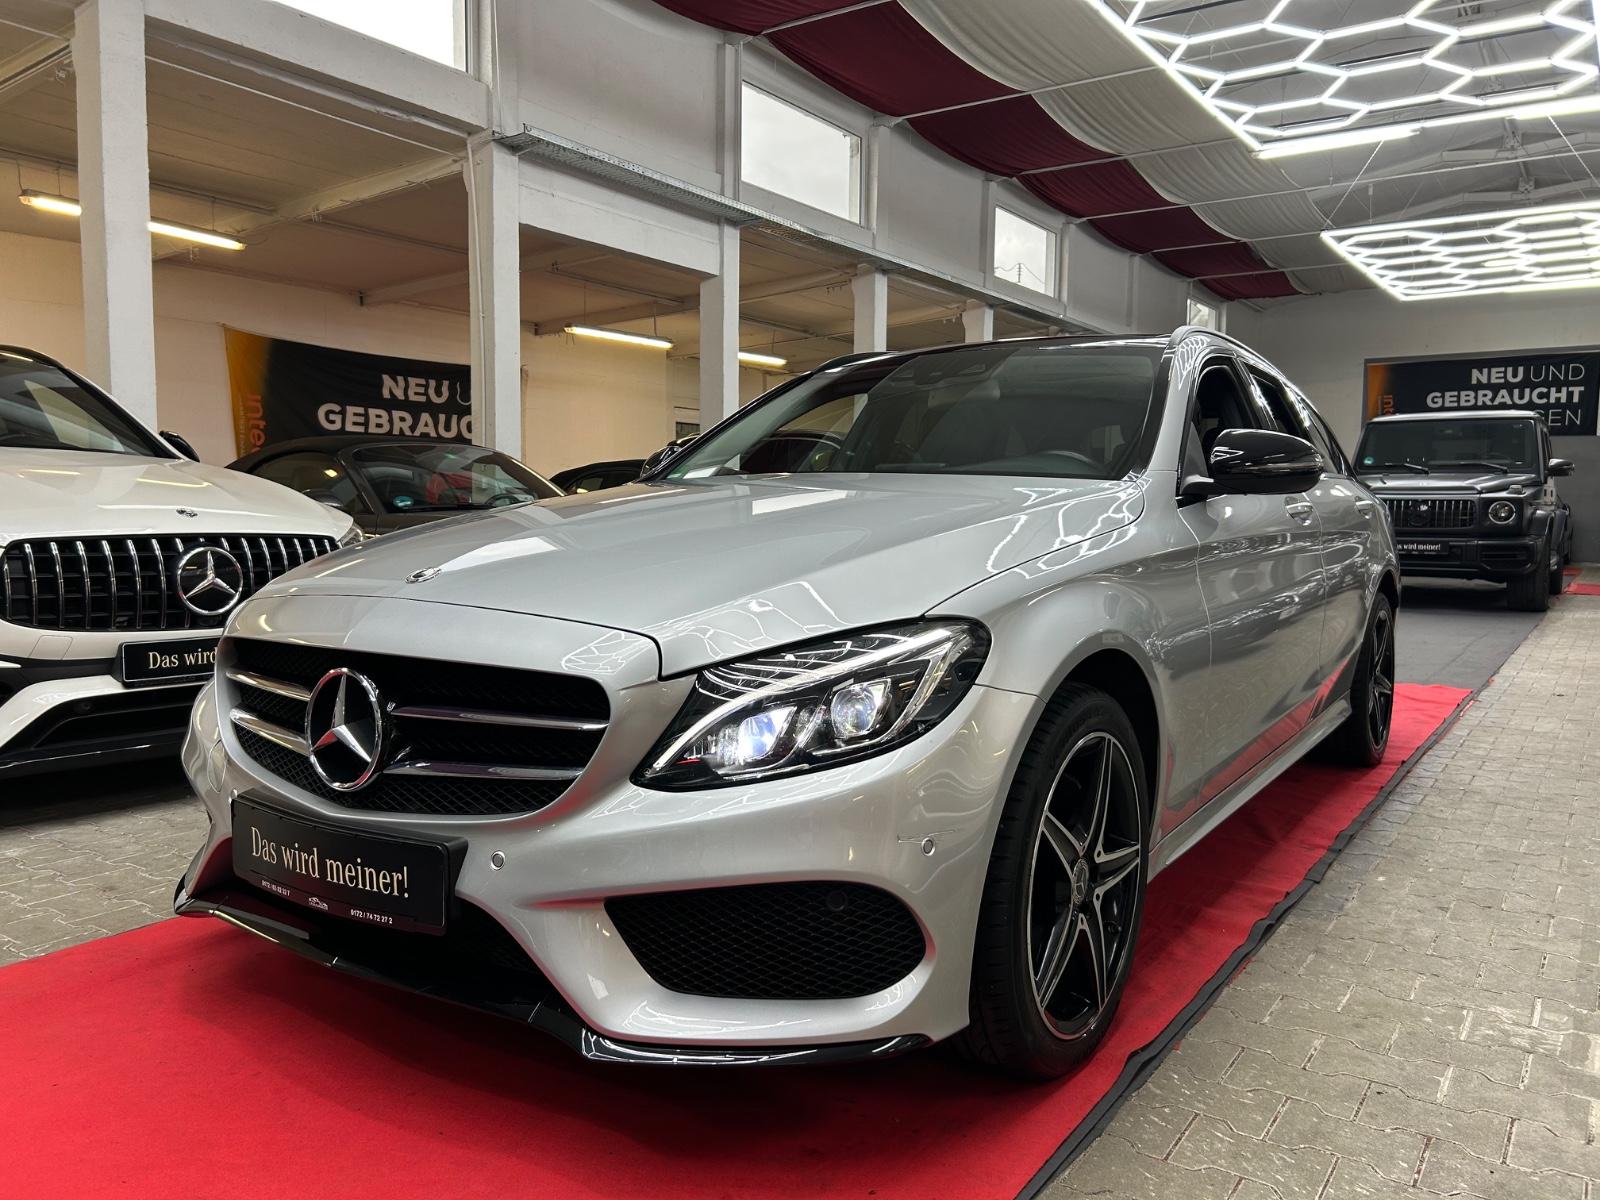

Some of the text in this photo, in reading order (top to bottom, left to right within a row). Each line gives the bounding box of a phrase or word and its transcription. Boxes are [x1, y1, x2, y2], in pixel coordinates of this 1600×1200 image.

[1471, 363, 1585, 385] NEU UND
[382, 374, 449, 405] NEU
[1426, 386, 1585, 409] GEBRAUCHT
[148, 651, 179, 669] Das
[251, 826, 277, 864] Das
[281, 842, 320, 879] wird
[325, 857, 409, 899] meiner!
